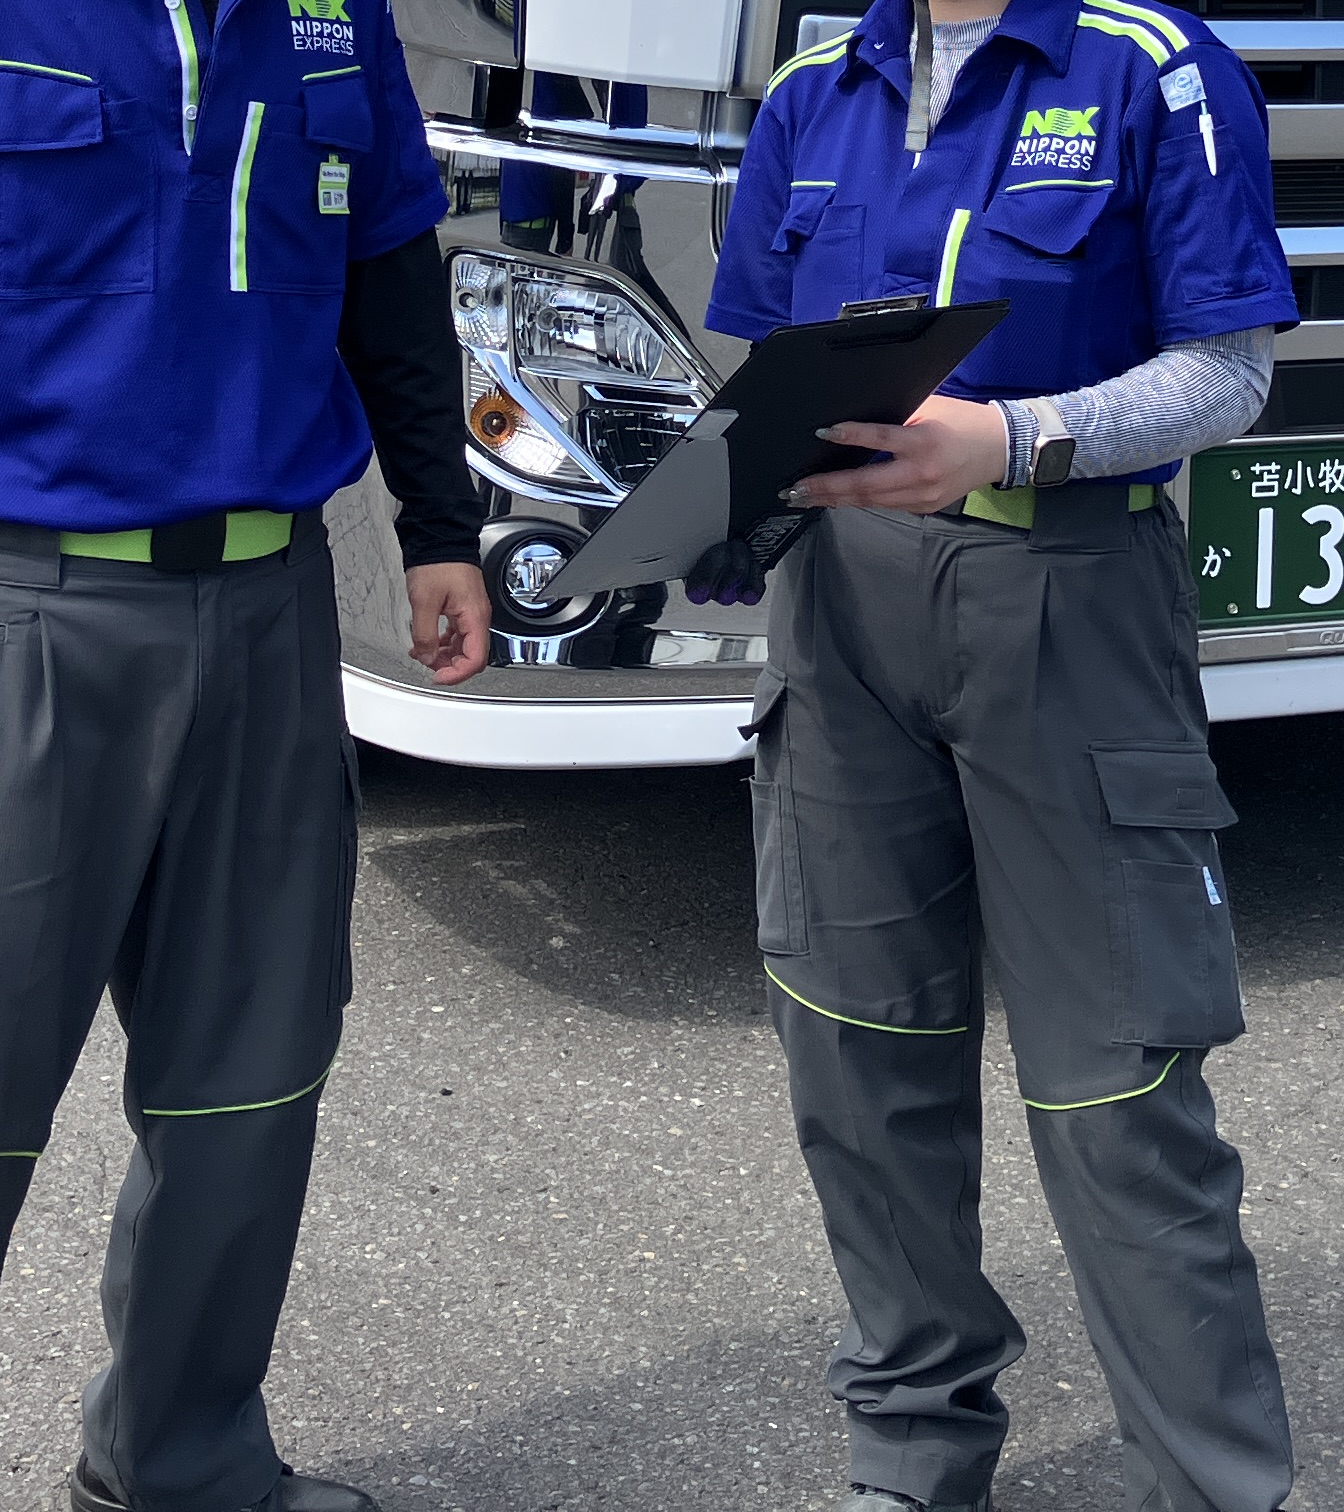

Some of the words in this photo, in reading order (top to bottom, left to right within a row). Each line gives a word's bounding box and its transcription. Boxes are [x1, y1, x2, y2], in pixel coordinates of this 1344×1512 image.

[291, 20, 354, 40] NIPPON
[293, 36, 354, 56] EXPRESS
[1015, 137, 1096, 156] NIPPON
[1011, 151, 1093, 171] EXPRESS
[1201, 545, 1232, 578] か
